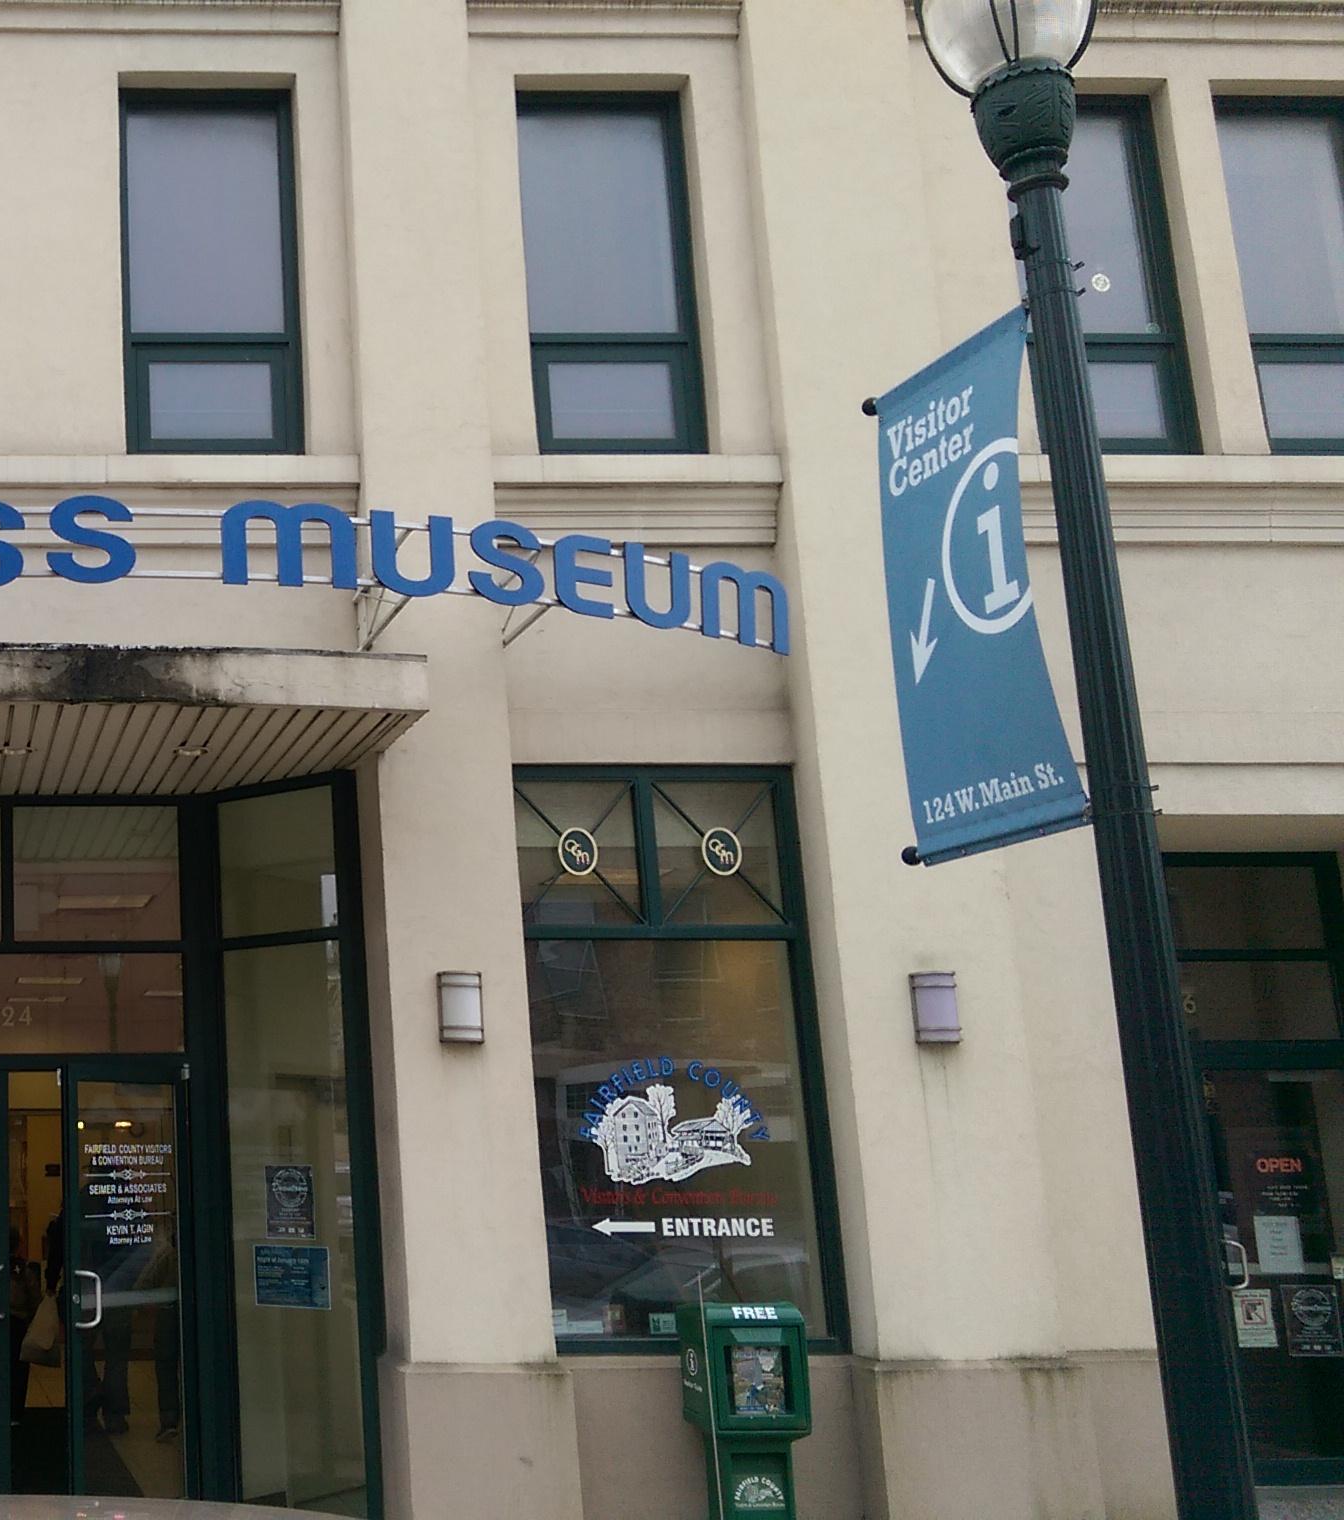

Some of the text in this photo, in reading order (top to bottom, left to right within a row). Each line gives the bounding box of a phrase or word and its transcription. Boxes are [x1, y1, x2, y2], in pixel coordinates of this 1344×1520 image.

[886, 385, 974, 460] Visitor
[888, 423, 974, 497] Center
[221, 500, 791, 656] MUSEUM
[923, 762, 1065, 824] 124 W. Main St.
[578, 1056, 770, 1141] FAIRFIELD COUNTY
[84, 1144, 172, 1154] FAIRFIELD COUNTY VISITORS
[98, 1156, 137, 1165] CONVENTION
[139, 1155, 164, 1164] BUREAU
[1256, 1157, 1302, 1174] OPEN
[89, 1185, 116, 1195] SEIMER
[124, 1183, 167, 1194] ASSOCIATES
[106, 1225, 128, 1235] KEVIN
[137, 1224, 154, 1233] AGIN
[661, 1217, 775, 1237] ENTRANCE
[732, 1307, 778, 1320] FREE
